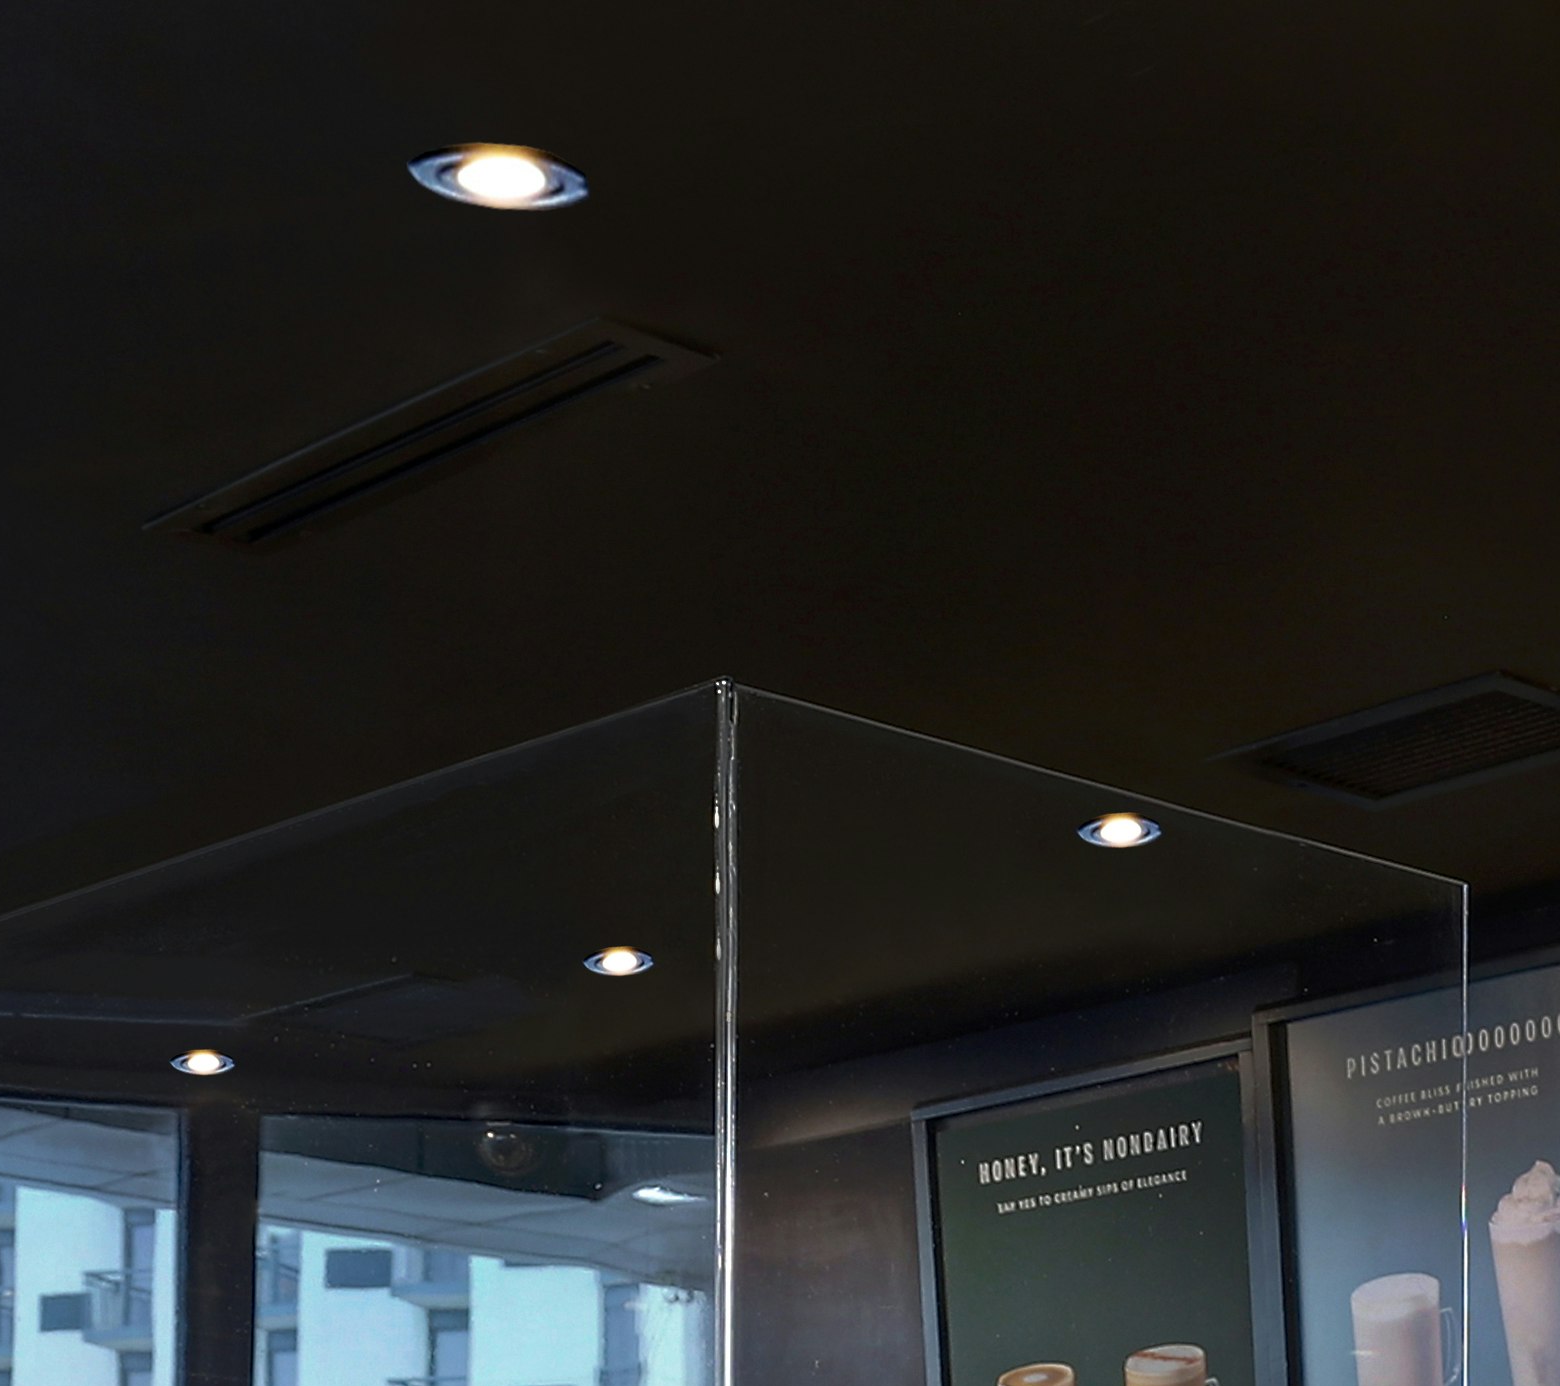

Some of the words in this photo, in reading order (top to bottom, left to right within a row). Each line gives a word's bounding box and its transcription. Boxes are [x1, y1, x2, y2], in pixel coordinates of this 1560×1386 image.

[979, 1153, 1046, 1184] HONEY,
[1055, 1142, 1093, 1170] IT'S
[1102, 1121, 1202, 1161] NONDAIRY
